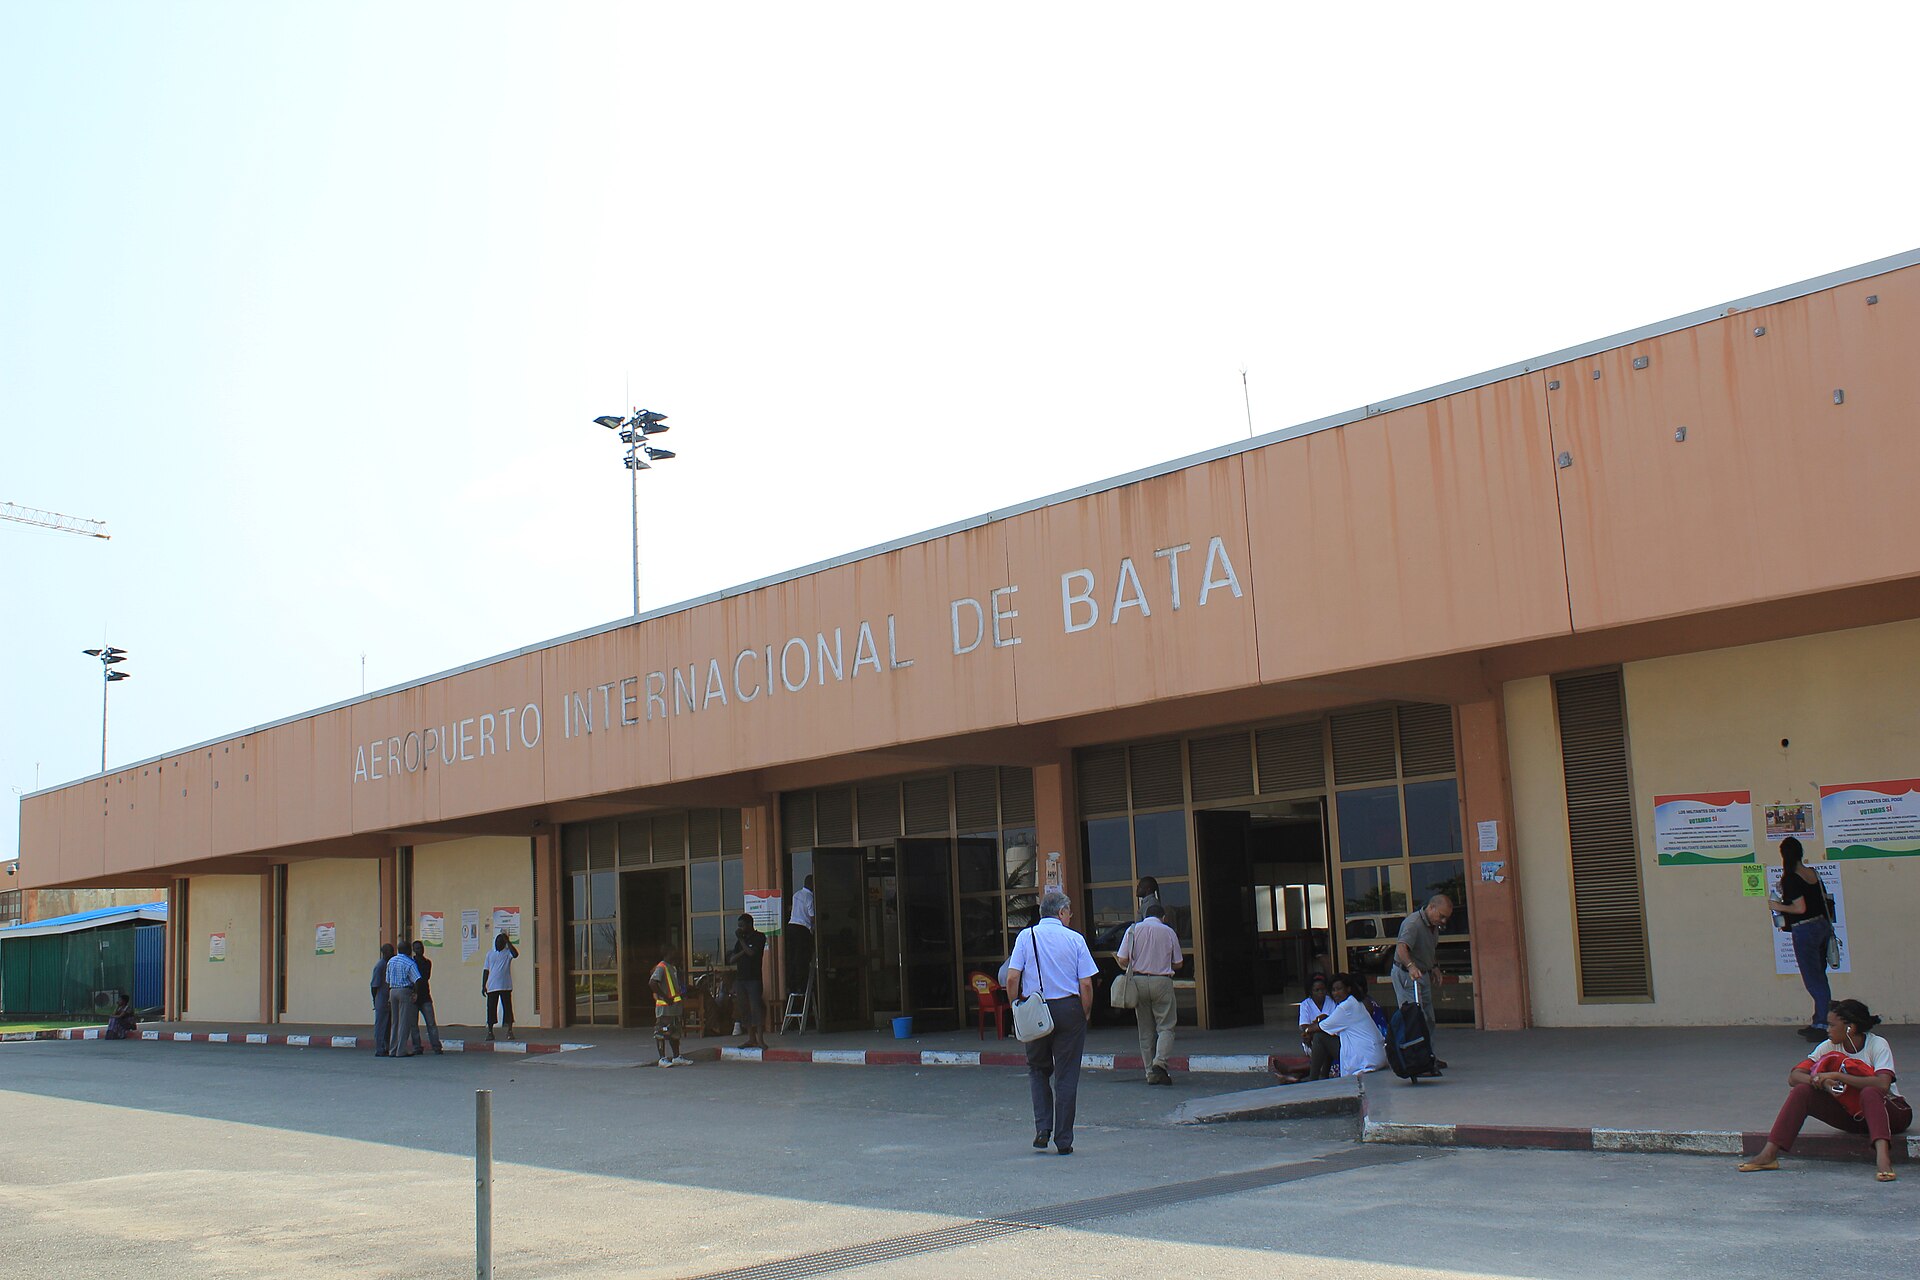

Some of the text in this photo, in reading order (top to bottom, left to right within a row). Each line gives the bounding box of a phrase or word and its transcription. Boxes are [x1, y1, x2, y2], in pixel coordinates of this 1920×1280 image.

[353, 536, 1243, 783] AEROPUERTO INTERNACIONAL DE BATA
[1859, 806, 1885, 815] VOTAMOS
